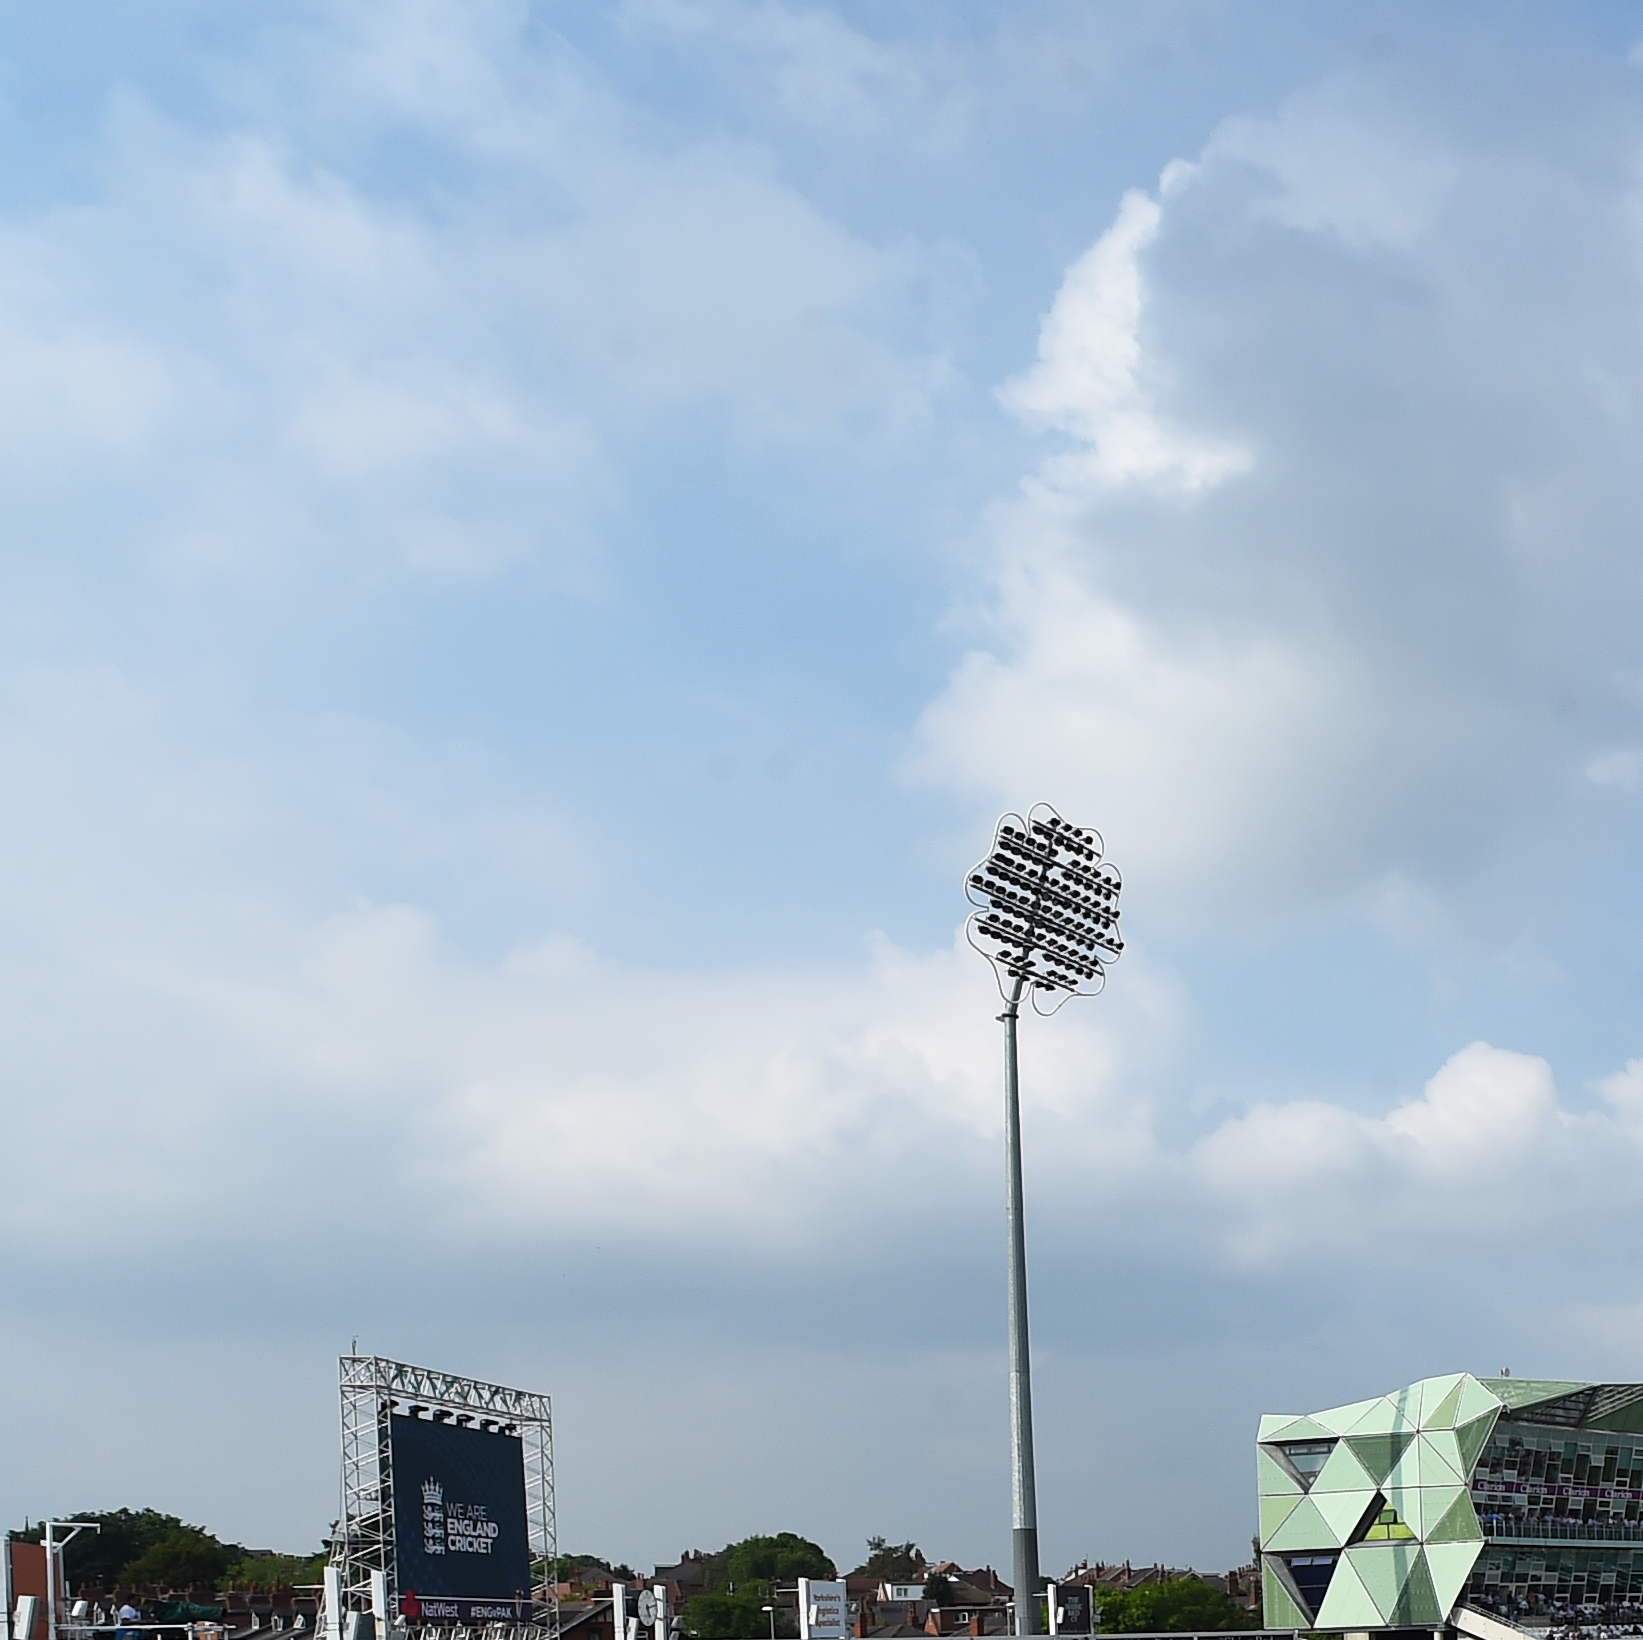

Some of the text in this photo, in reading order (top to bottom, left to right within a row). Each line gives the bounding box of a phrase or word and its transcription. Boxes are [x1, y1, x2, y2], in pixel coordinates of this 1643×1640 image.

[446, 1502, 488, 1520] WE ARE
[446, 1518, 499, 1538] ENGLAND
[448, 1535, 493, 1554] CRICKET
[421, 1602, 459, 1618] NatWest
